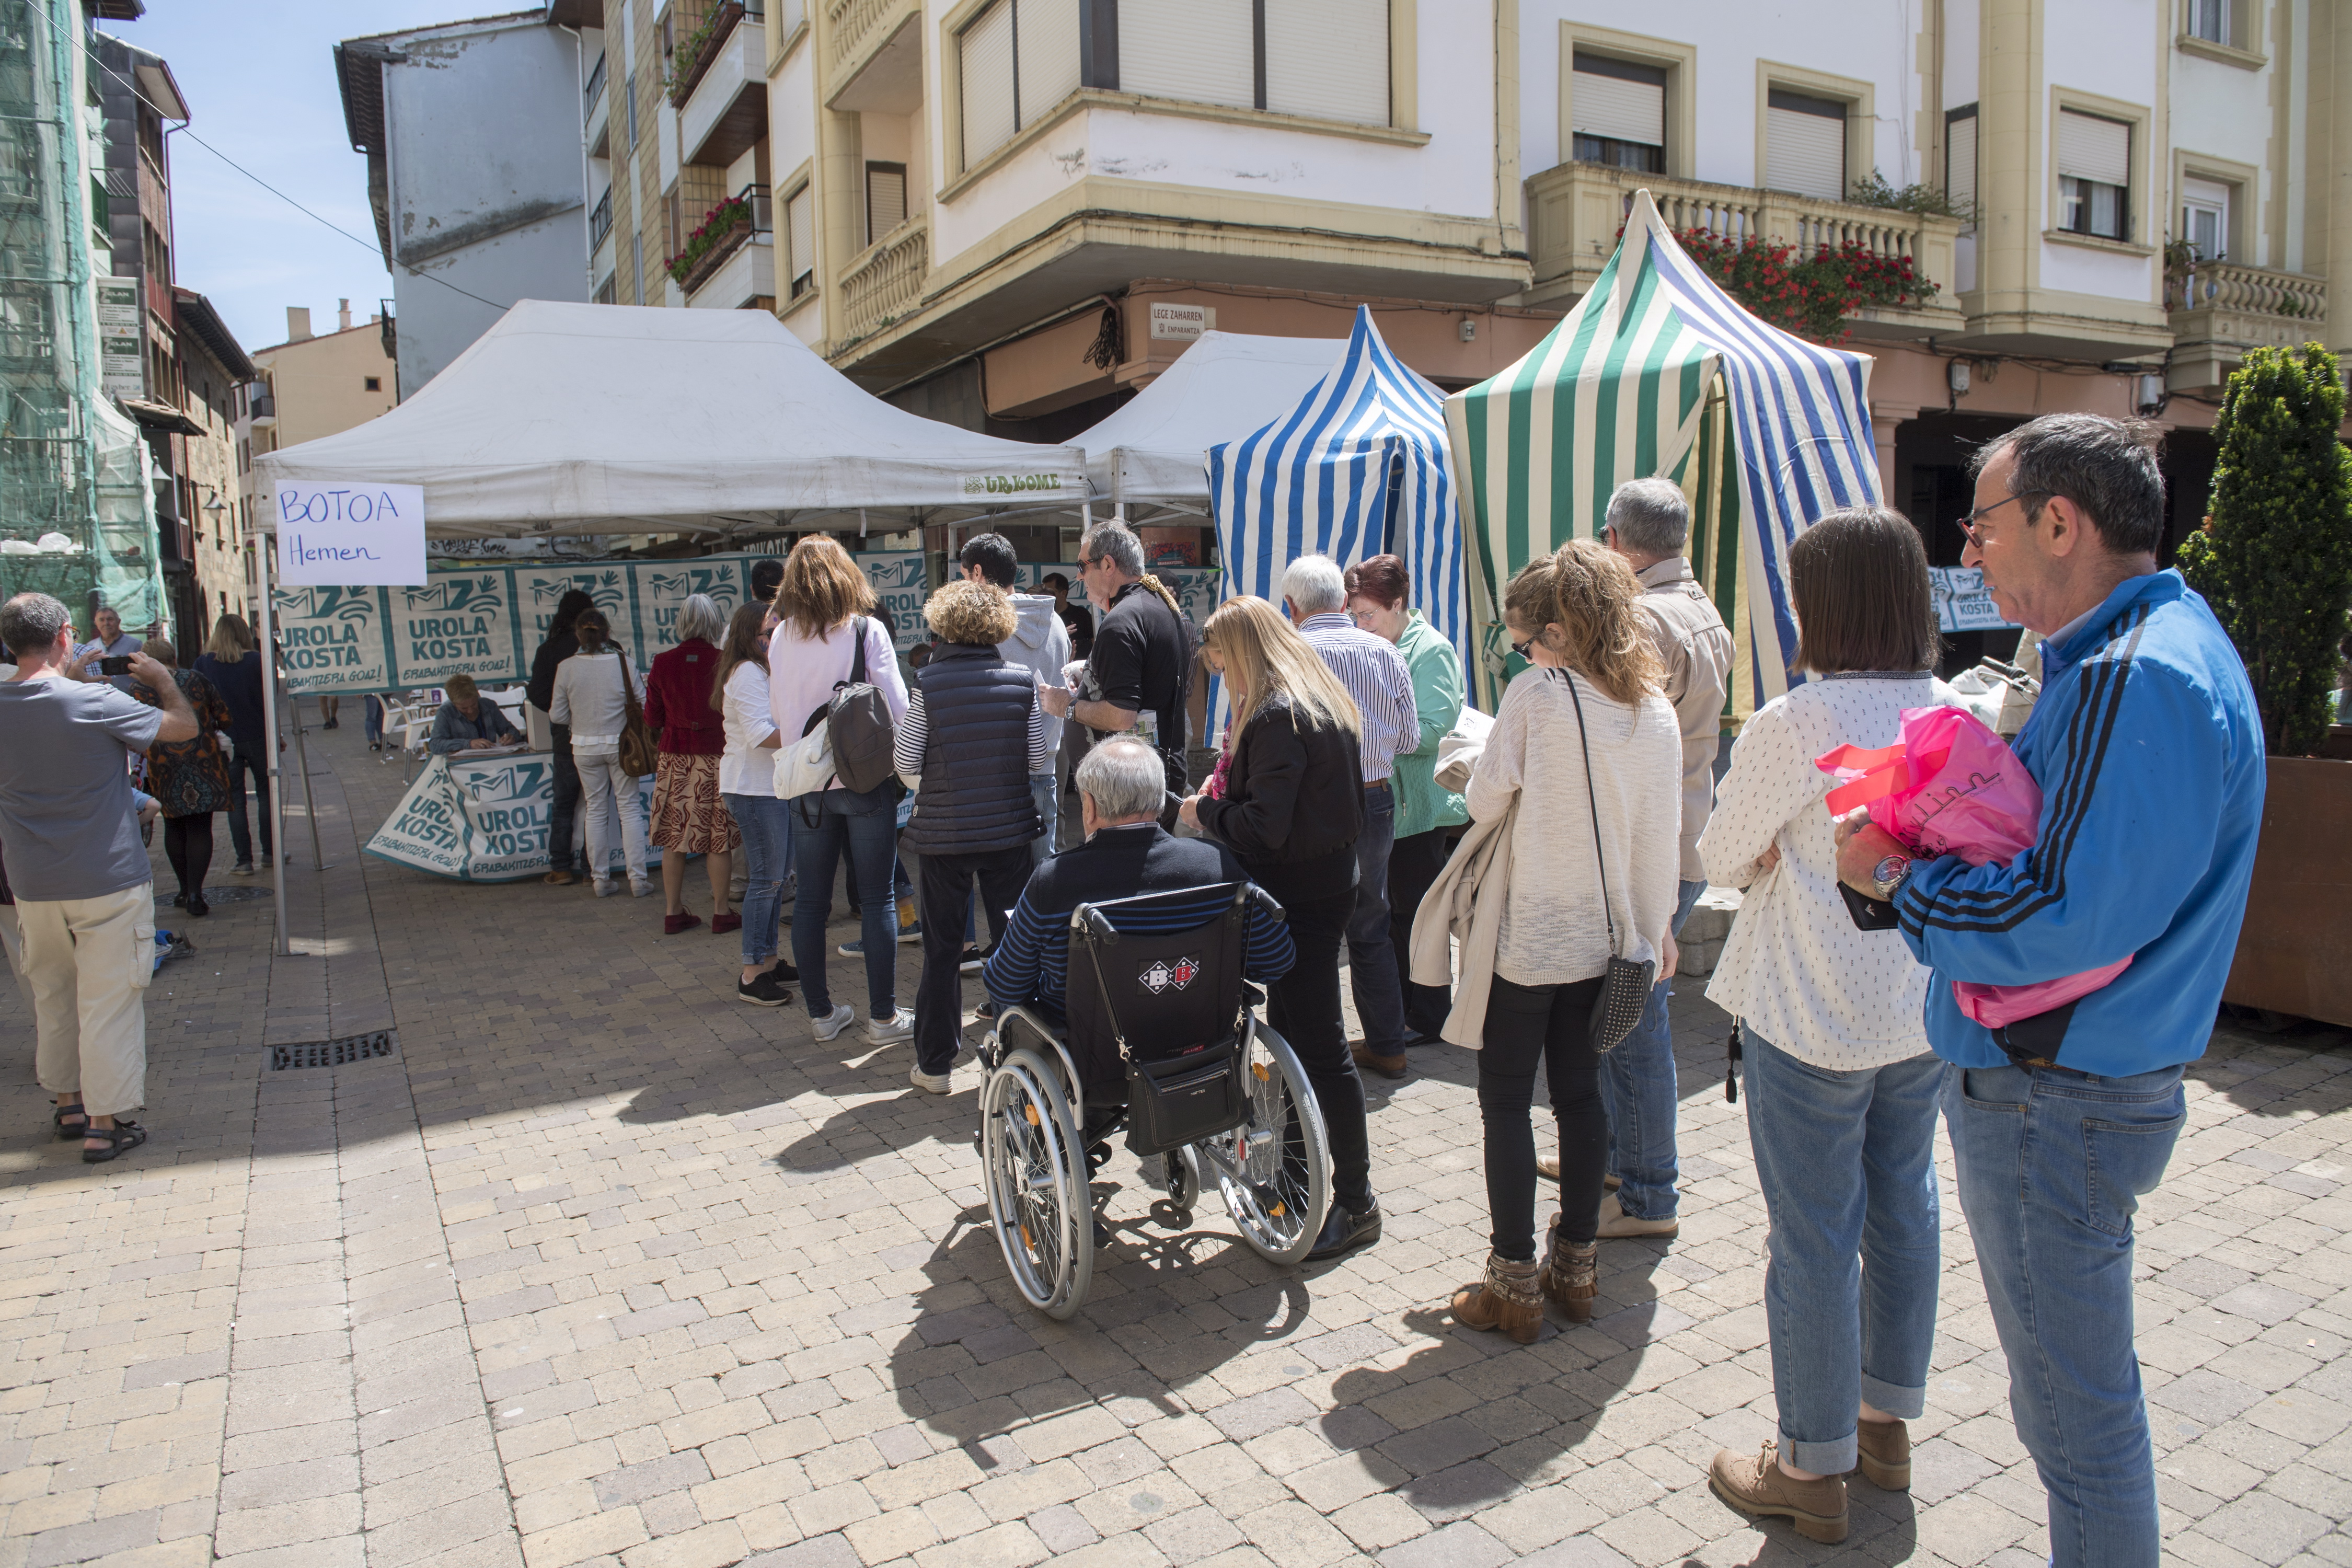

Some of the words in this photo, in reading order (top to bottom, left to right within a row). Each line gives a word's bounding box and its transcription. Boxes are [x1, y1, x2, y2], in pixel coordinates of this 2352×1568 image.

[1154, 309, 1168, 319] LEGE
[1170, 310, 1203, 321] ZAHARREN
[1168, 326, 1200, 335] ENPARANTZA
[984, 473, 1060, 494] URKOME
[280, 490, 398, 523] BOTOA
[290, 534, 381, 566] Hemen
[1959, 603, 1994, 615] KOSTA
[408, 616, 489, 639] UROLA
[412, 637, 492, 661] KOSTA
[348, 664, 382, 683] GOAZ!
[403, 662, 476, 681] ERABAKITZERA
[479, 655, 511, 673] GOAZ!
[393, 813, 458, 851] KOSTA
[485, 827, 549, 855] KOST
